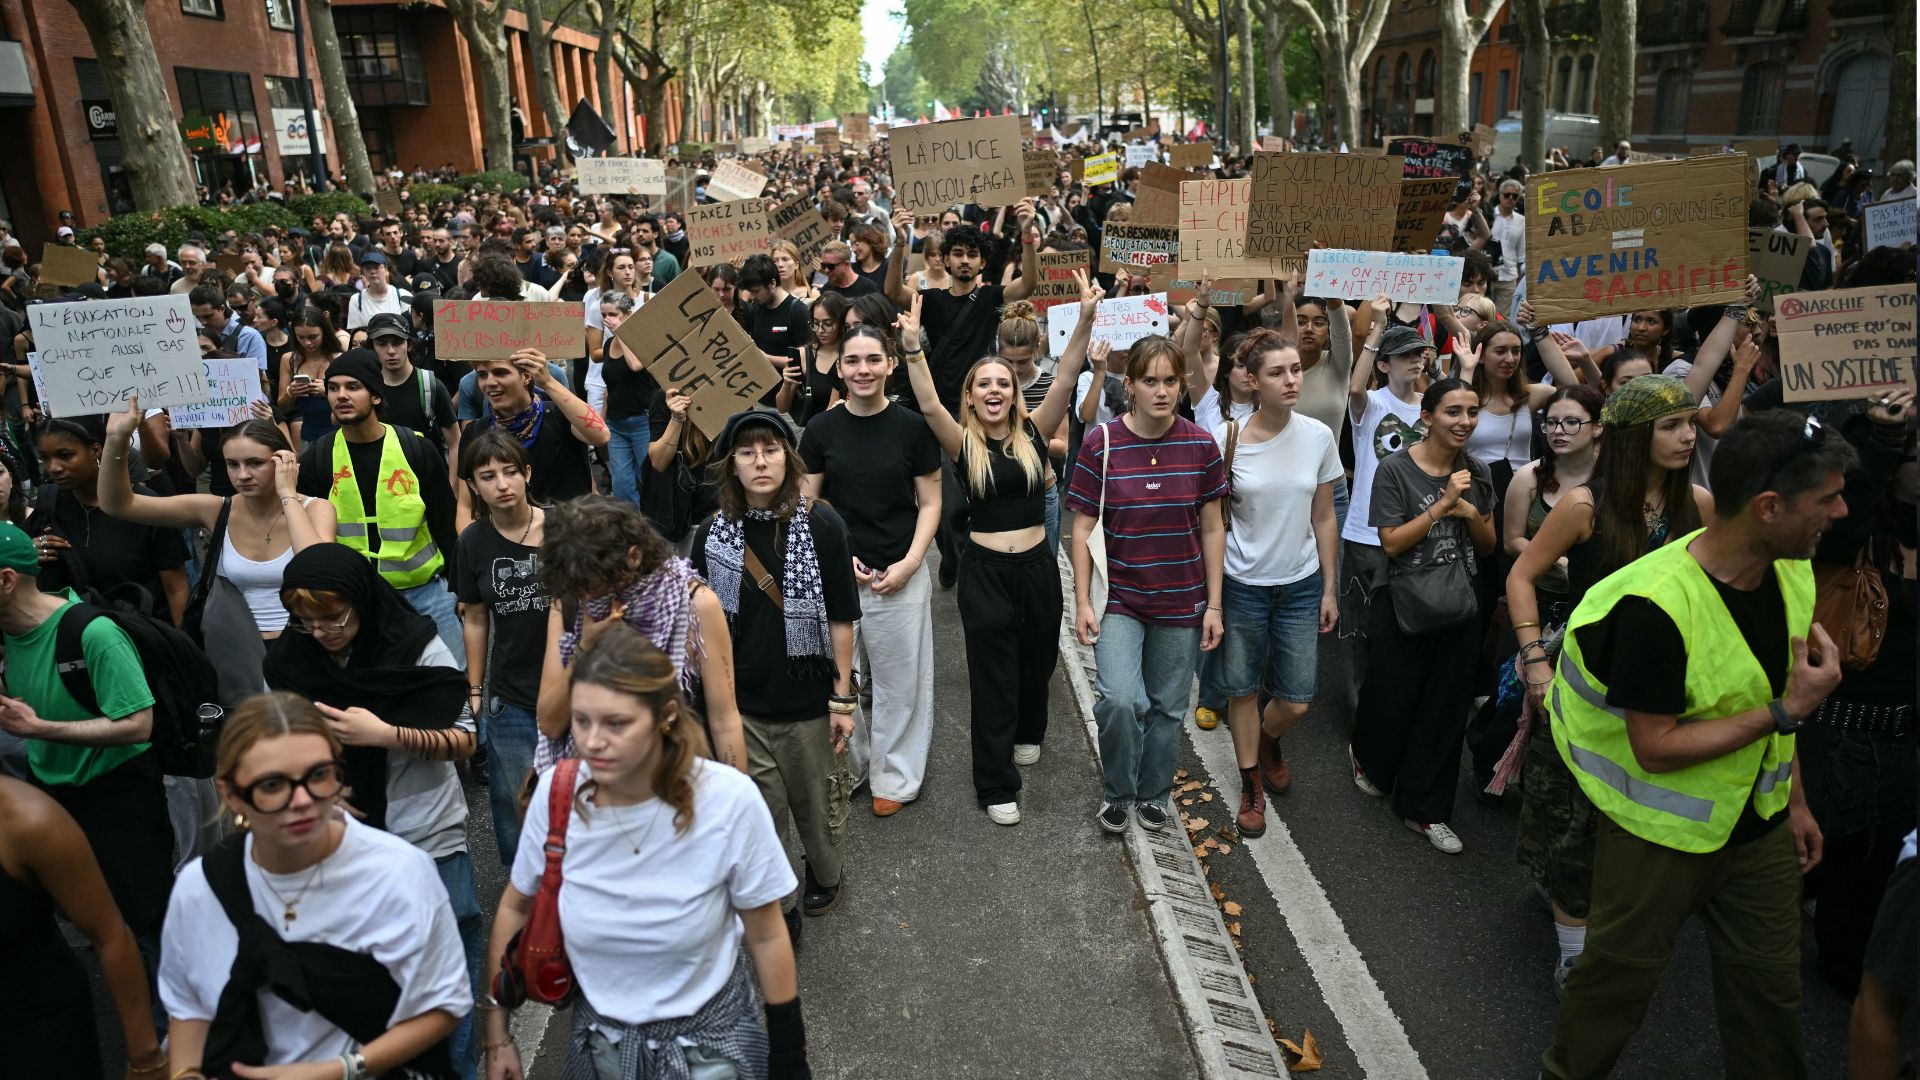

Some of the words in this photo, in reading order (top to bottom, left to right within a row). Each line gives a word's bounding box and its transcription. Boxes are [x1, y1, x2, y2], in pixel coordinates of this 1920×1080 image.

[932, 138, 1001, 163] POLICE
[1402, 143, 1438, 157] TROP
[1333, 155, 1391, 187] POUR
[900, 177, 965, 212] GOUGOU
[1182, 181, 1250, 206] EMPLO
[1253, 183, 1277, 202] LE
[688, 204, 733, 223] TAXEZ
[741, 202, 763, 215] LES
[1250, 203, 1284, 220] NOUS
[1291, 205, 1354, 223] ESSAYONS
[1362, 208, 1382, 222] DE
[1547, 193, 1744, 237] ABANDONNÉE
[688, 223, 734, 241] RICHES
[738, 220, 762, 232] PAS
[1106, 224, 1126, 238] PAS
[1127, 226, 1159, 239] BESOIN
[1160, 229, 1171, 240] DE
[1250, 220, 1313, 235] SAUVER
[1248, 236, 1311, 253] NOTRE
[1314, 224, 1392, 253] AVENIR
[1768, 234, 1798, 256] UN
[694, 245, 715, 258] NOS
[1040, 252, 1088, 266] MINISTRE
[1132, 253, 1145, 264] ME
[1180, 239, 1202, 262] LE
[1351, 267, 1372, 278] ON
[1375, 270, 1388, 281] SE
[1394, 271, 1425, 283] FAIT
[1537, 247, 1659, 285] AVENIR
[1030, 284, 1050, 296] OUS
[1052, 284, 1064, 295] ON
[1583, 258, 1743, 307] SACRIFIÉ
[1209, 289, 1246, 305] ROITS
[1875, 294, 1917, 308] TOTA
[39, 305, 154, 328] L'ÉDUCATION
[434, 300, 462, 323] 1
[467, 301, 520, 322] PROF
[1119, 311, 1151, 325] SALES
[67, 323, 158, 343] NATIONALE
[1814, 321, 1860, 337] PARCE
[1864, 319, 1912, 334] QU'ON
[42, 347, 95, 364] CHUTE
[111, 343, 144, 356] AUSSI
[156, 339, 185, 352] BAS
[463, 330, 496, 352] CRS
[678, 288, 717, 336] LA
[702, 330, 763, 399] POLICE
[1853, 339, 1880, 350] PAS
[77, 366, 115, 386] QUE
[130, 362, 158, 377] MA
[219, 363, 230, 377] LA
[652, 333, 716, 398] TUE
[1783, 362, 1815, 392] UN
[1821, 354, 1906, 388] SYSTÈME
[77, 381, 168, 407] MOYENNE
[220, 379, 248, 397] FAIT
[211, 412, 225, 421] UN
